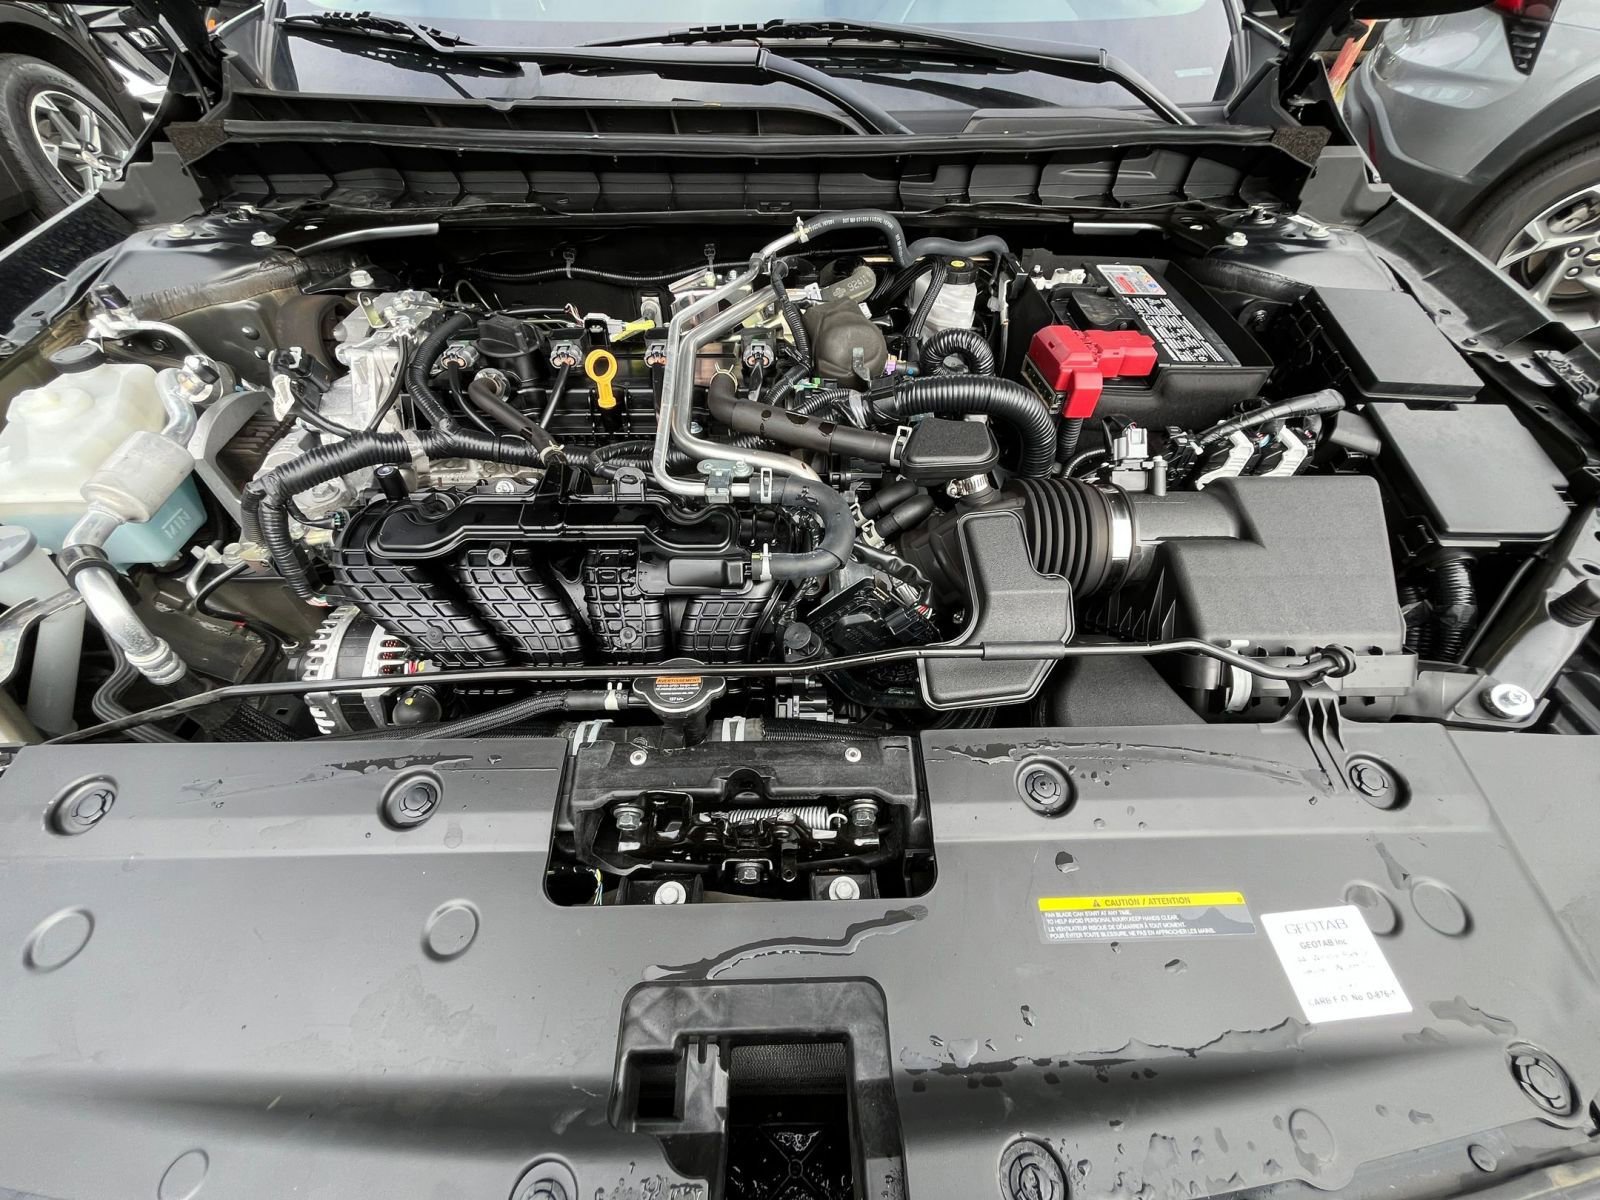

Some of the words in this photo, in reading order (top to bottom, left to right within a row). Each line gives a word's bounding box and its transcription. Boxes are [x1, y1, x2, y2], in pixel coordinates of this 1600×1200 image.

[164, 510, 192, 539] MIN
[1104, 898, 1140, 907] CAUTION
[1148, 896, 1191, 906] ATTENTION
[1284, 918, 1349, 935] GEOTAB
[1299, 938, 1335, 950] GEOTAB
